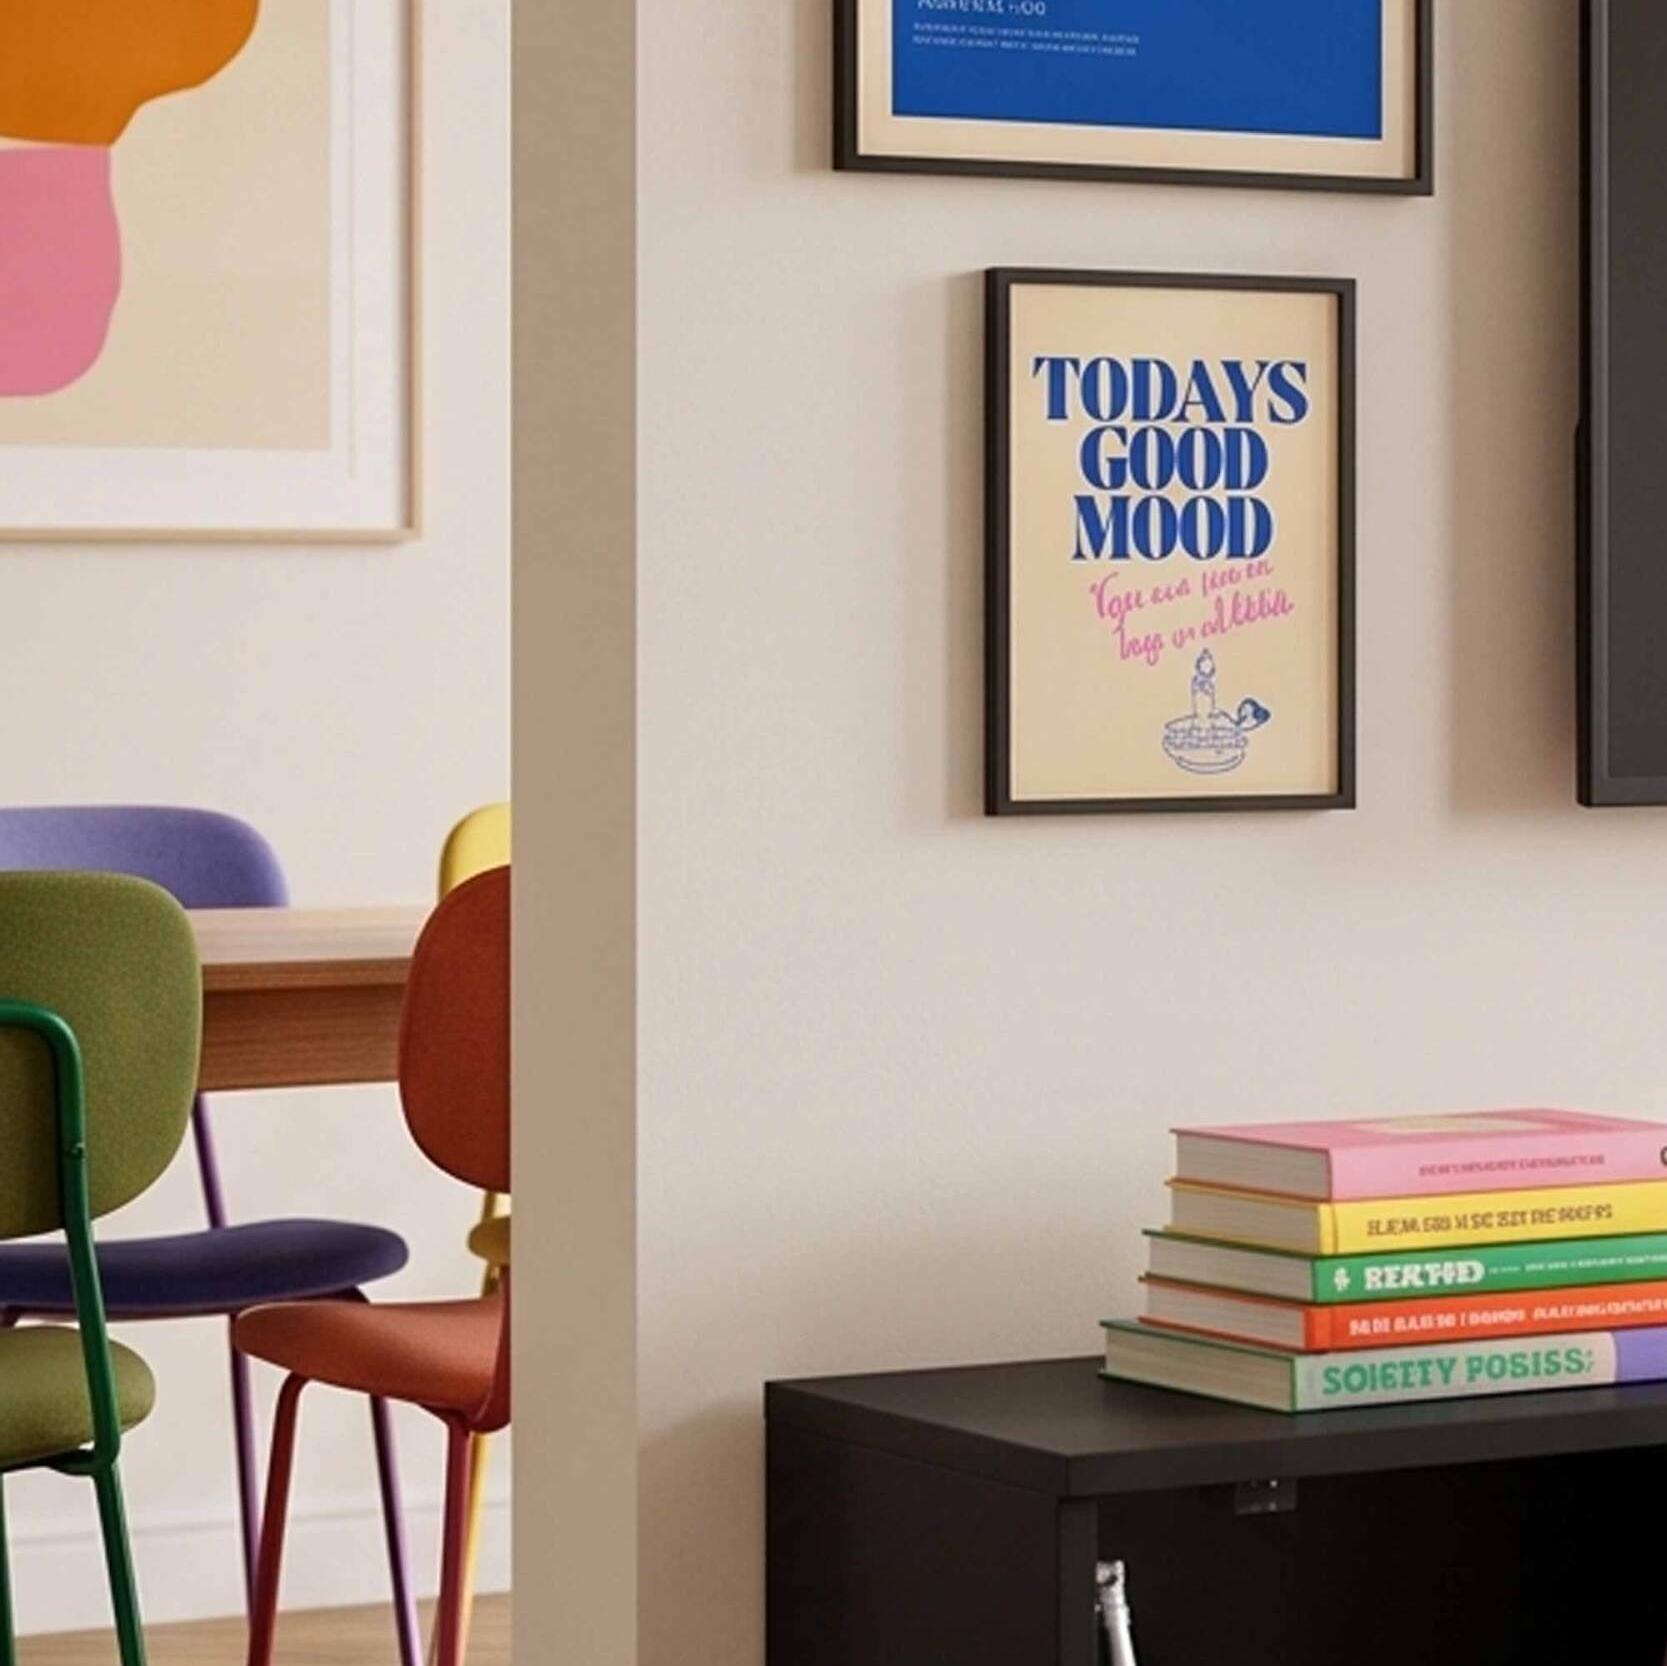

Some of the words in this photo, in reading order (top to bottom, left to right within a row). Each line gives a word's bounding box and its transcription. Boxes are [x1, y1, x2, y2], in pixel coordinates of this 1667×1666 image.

[1032, 357, 1309, 425] TODAYS
[1080, 426, 1268, 490] GOOD
[1072, 495, 1272, 560] MOOD
